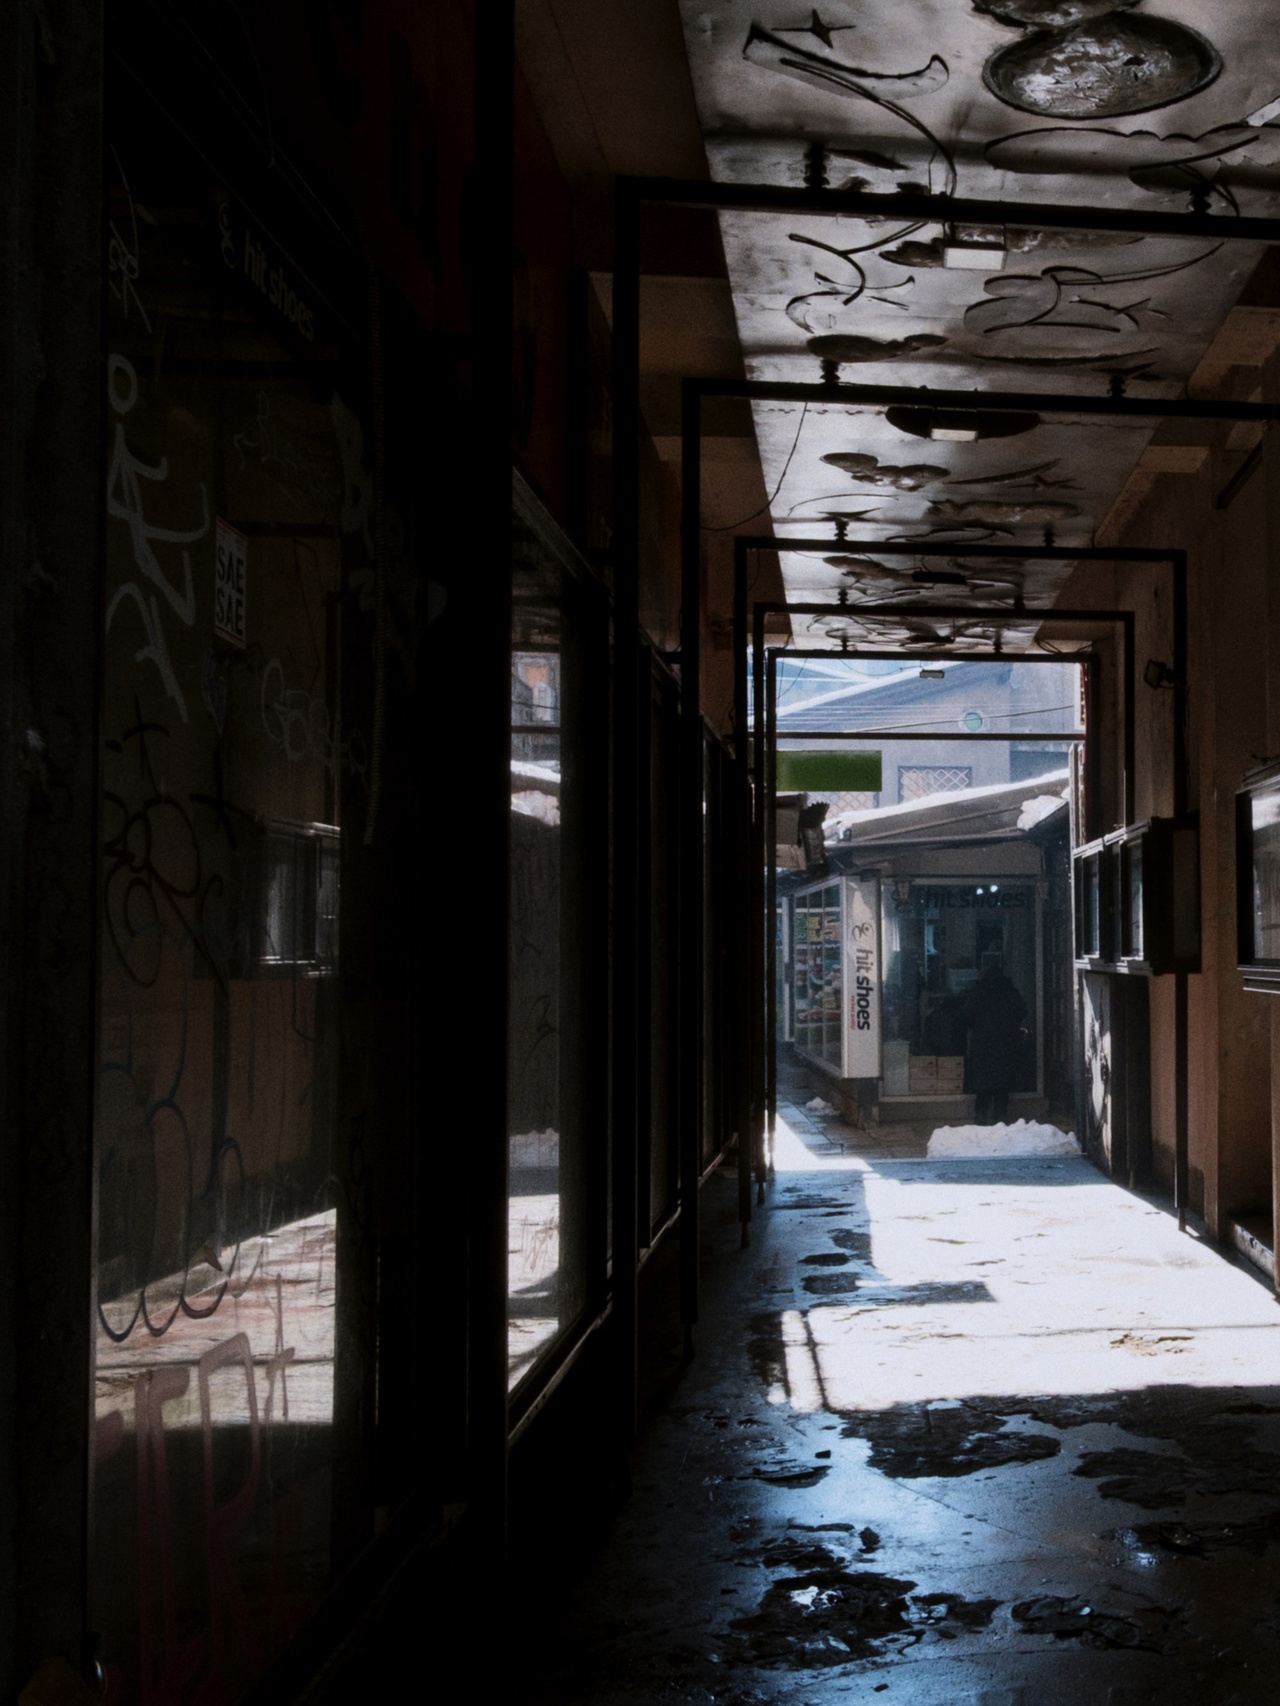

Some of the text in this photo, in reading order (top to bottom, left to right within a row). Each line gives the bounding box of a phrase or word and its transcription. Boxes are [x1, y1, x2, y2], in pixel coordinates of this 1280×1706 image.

[244, 228, 314, 342] hit shoes
[217, 545, 243, 596] SAE
[217, 587, 243, 637] SAE
[856, 949, 874, 1030] hit shoes
